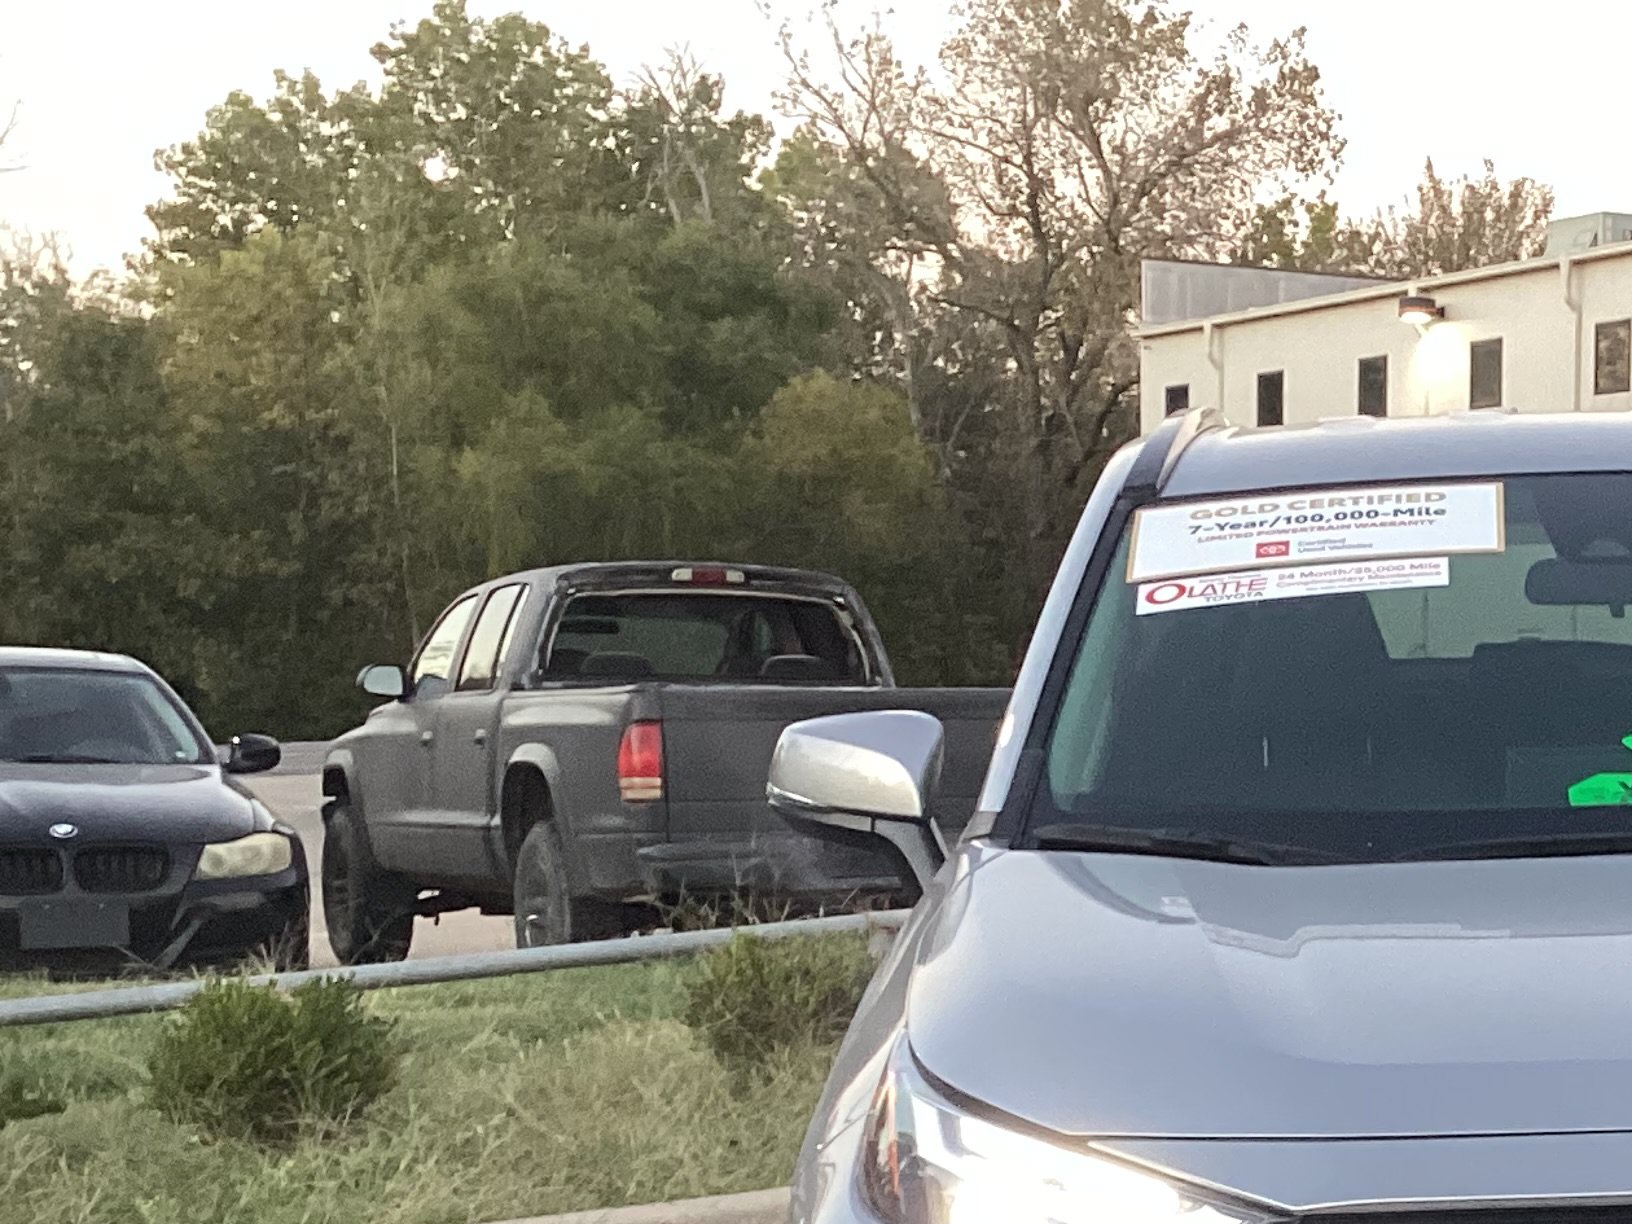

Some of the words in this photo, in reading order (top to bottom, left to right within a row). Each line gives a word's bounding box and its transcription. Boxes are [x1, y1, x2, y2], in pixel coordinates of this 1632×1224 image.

[1189, 502, 1280, 520] GOLD
[1287, 492, 1447, 511] CERTIFIED
[1188, 507, 1447, 535] 7-Year/100,000-Mile
[1197, 531, 1254, 543] LIMITED
[1256, 524, 1352, 537] POWERTRAIN
[1145, 577, 1269, 605] OLATHE
[1203, 591, 1264, 603] TOYOTA
